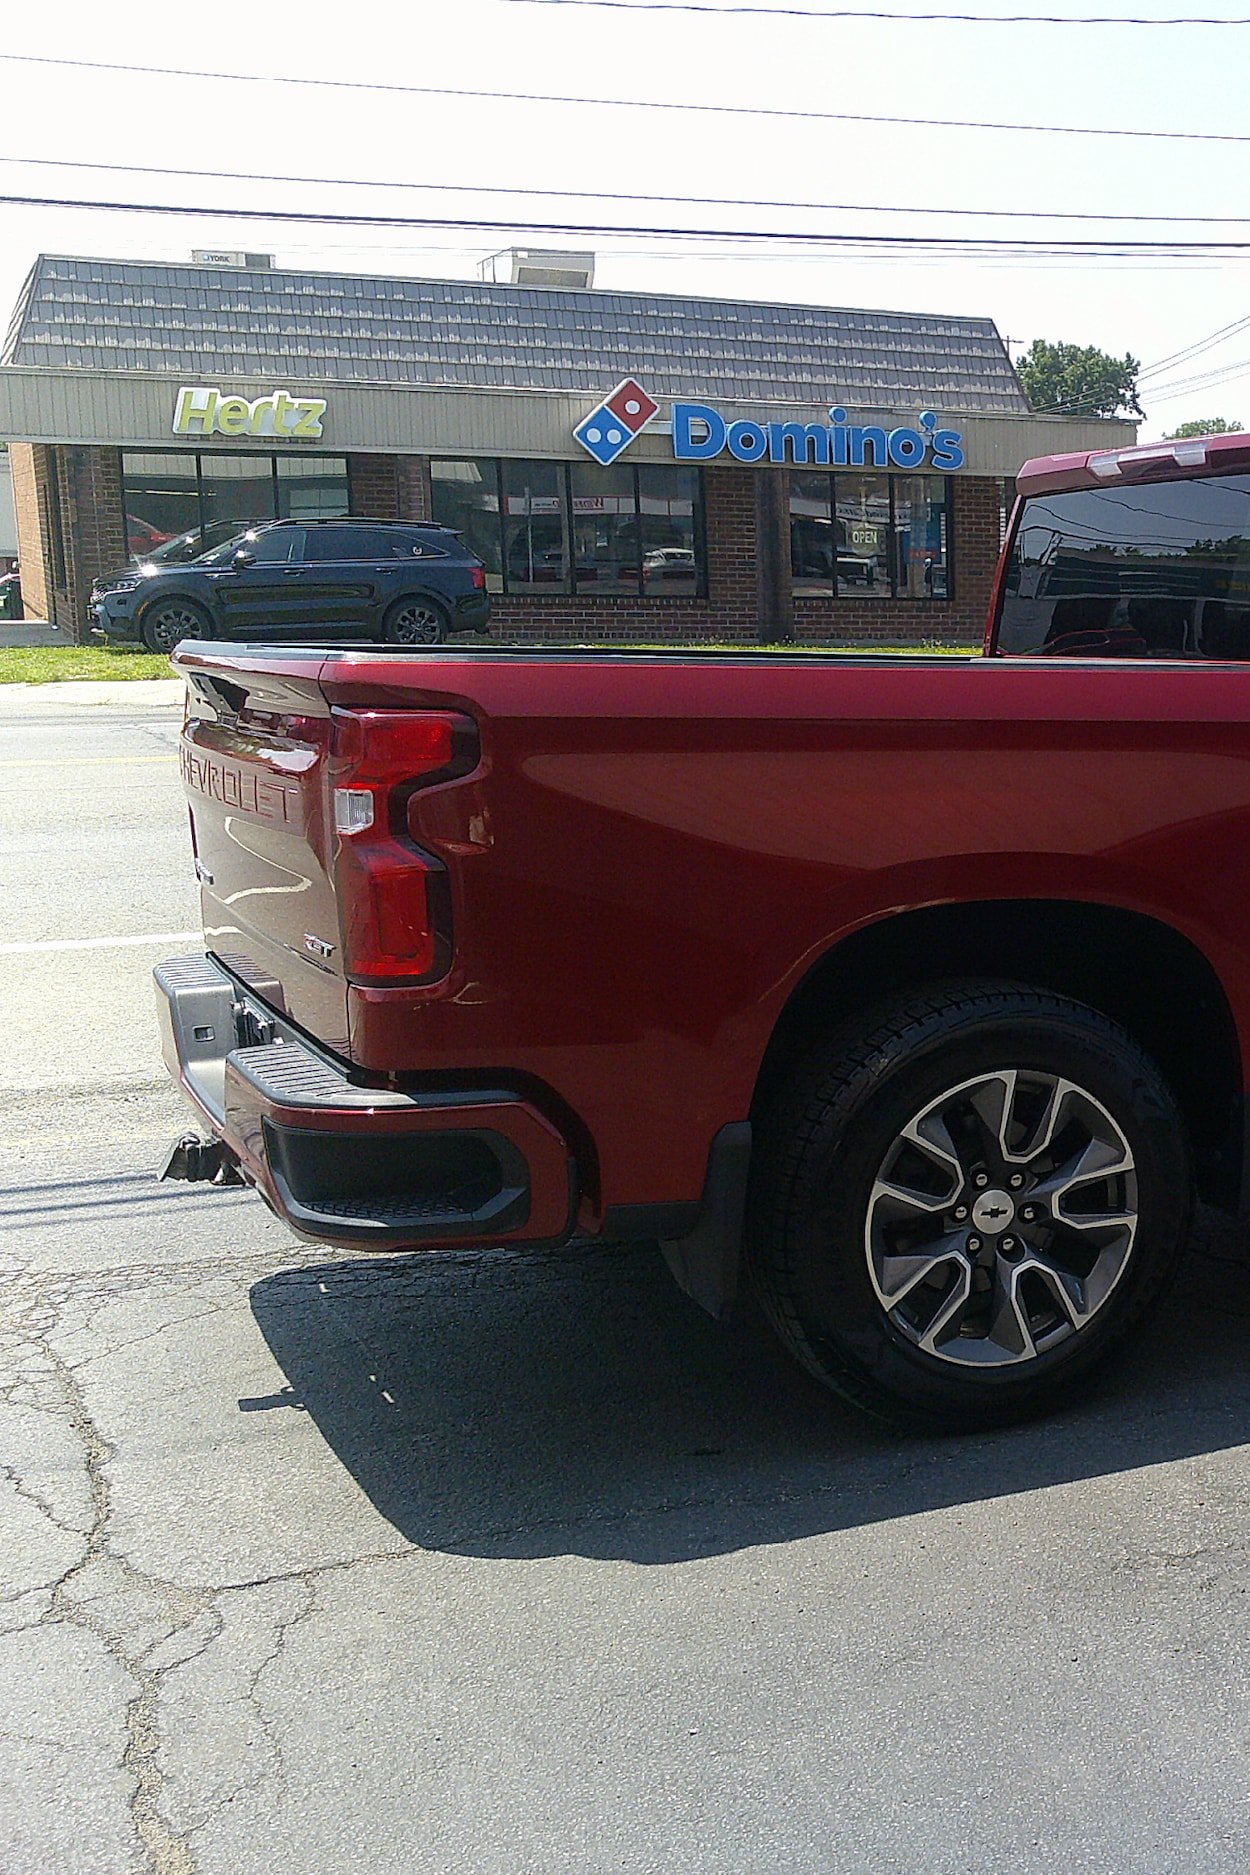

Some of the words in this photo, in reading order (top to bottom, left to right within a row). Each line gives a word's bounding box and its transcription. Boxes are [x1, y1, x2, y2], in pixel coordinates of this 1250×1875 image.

[210, 254, 231, 263] YORK
[176, 389, 325, 436] Hertz
[671, 402, 965, 471] Domino's
[852, 530, 878, 545] OPEN
